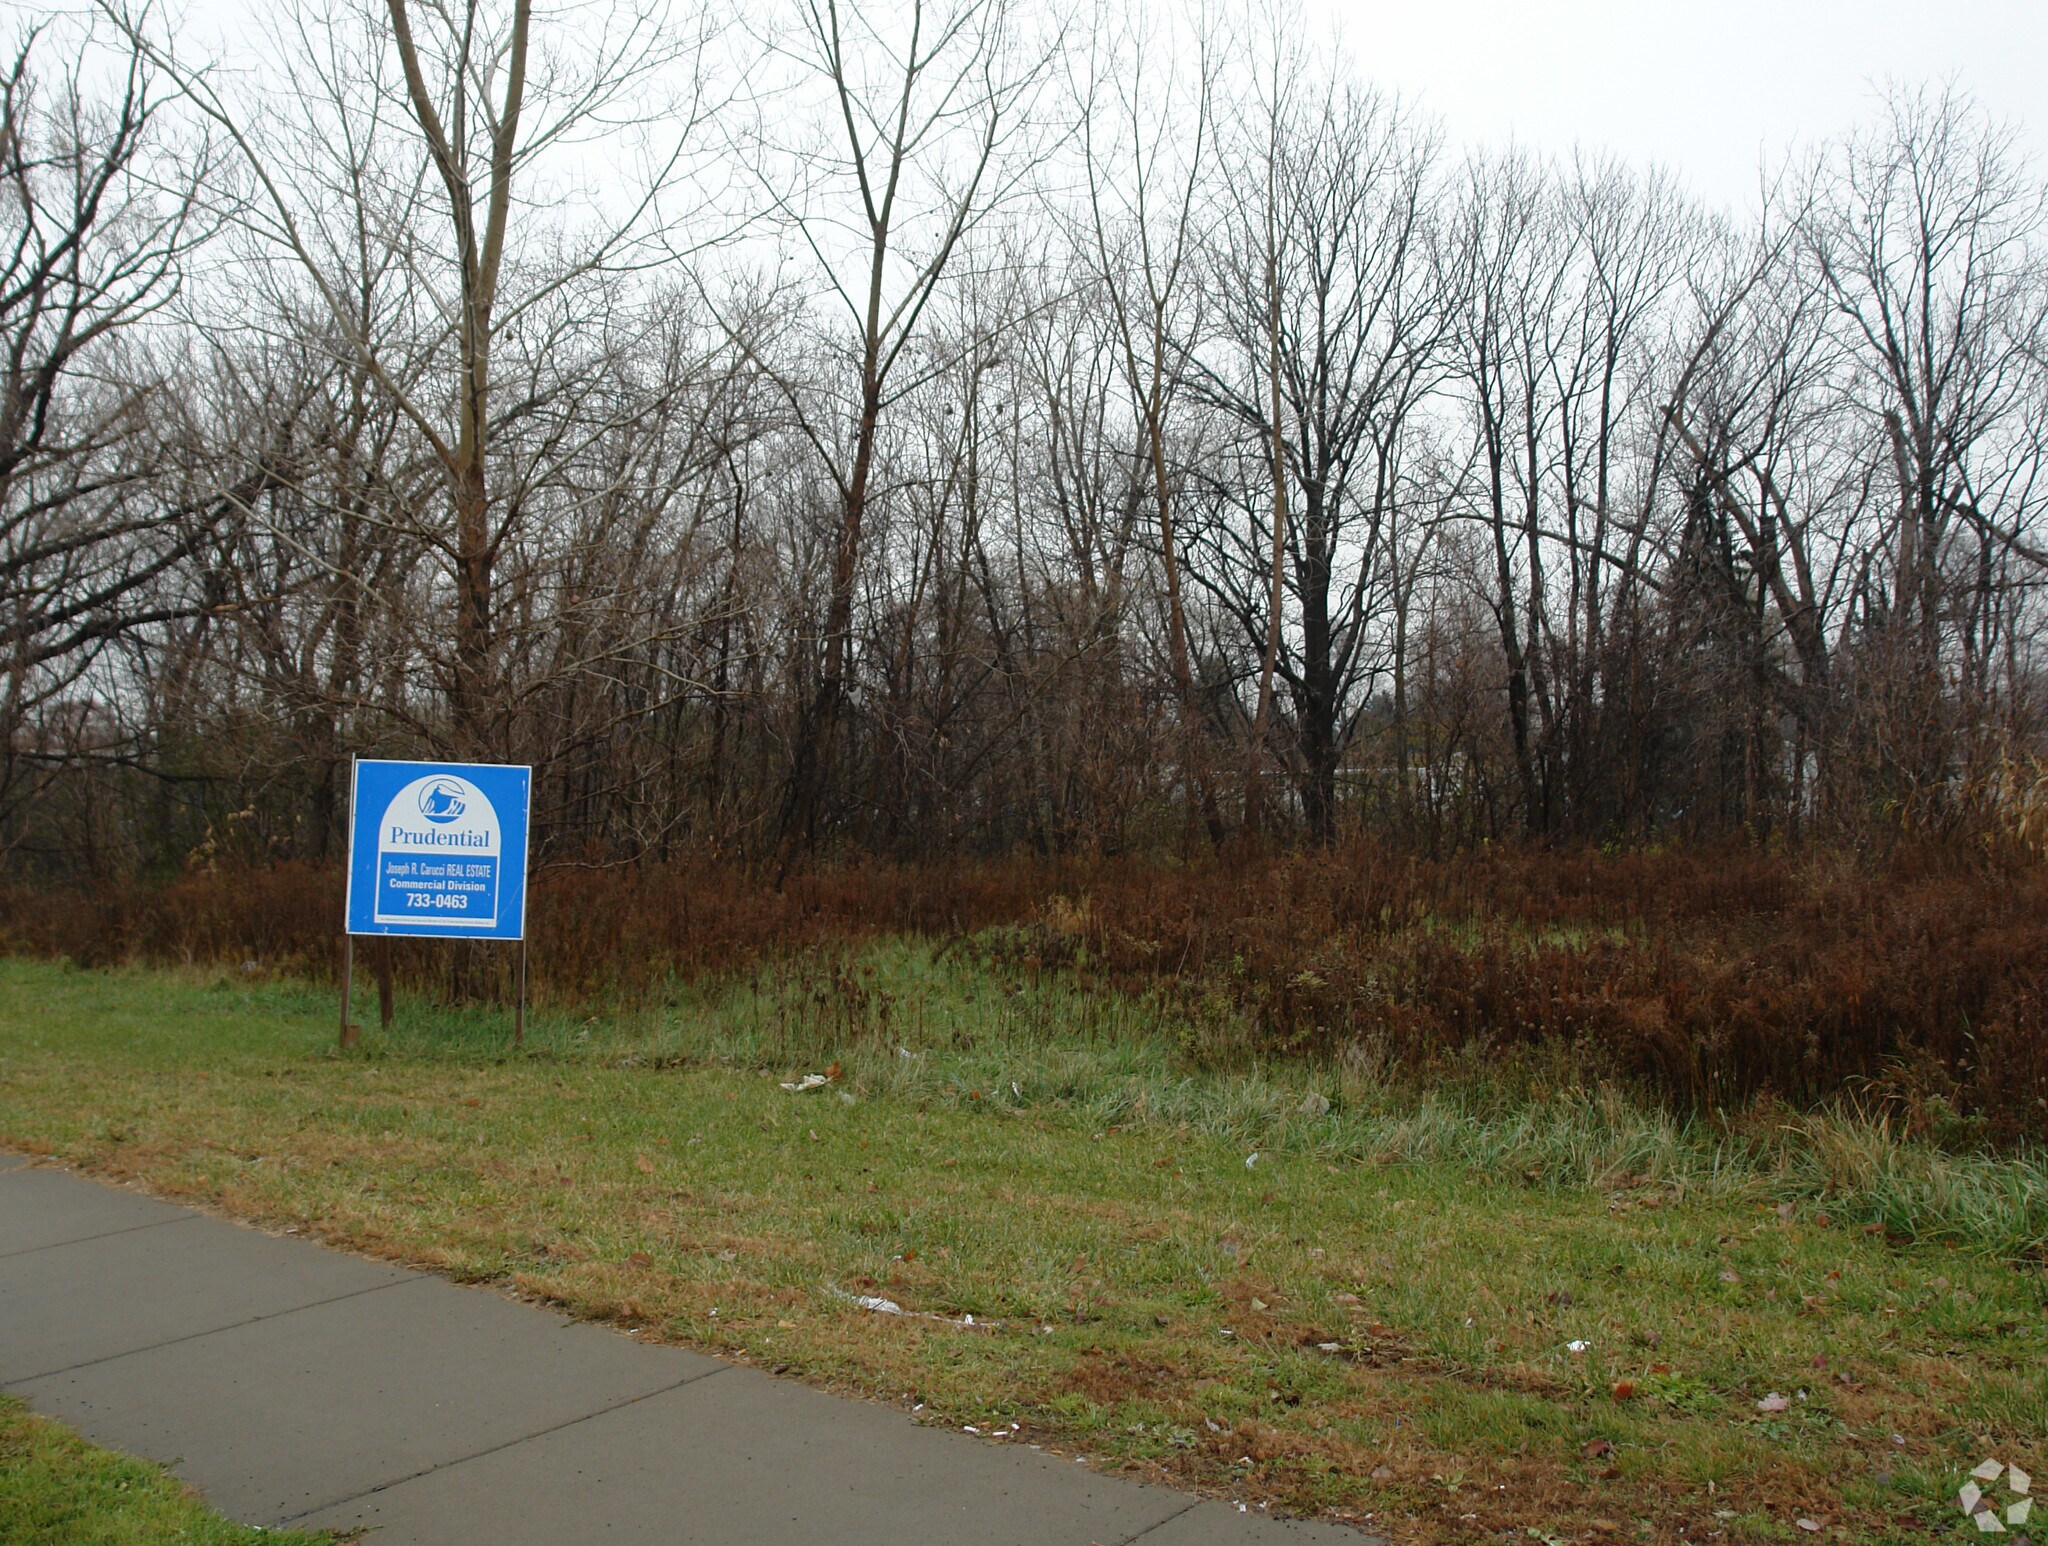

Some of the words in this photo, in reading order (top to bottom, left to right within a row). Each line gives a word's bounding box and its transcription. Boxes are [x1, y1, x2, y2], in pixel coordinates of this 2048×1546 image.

[390, 826, 490, 847] Prudential
[386, 861, 410, 877] Joseph
[411, 862, 418, 875] R.
[420, 862, 445, 876] Carucci
[446, 863, 465, 877] REAL
[466, 864, 491, 878] ESTATE
[389, 878, 445, 890] Commercial
[447, 880, 486, 891] Division
[406, 893, 468, 909] 733-0463
